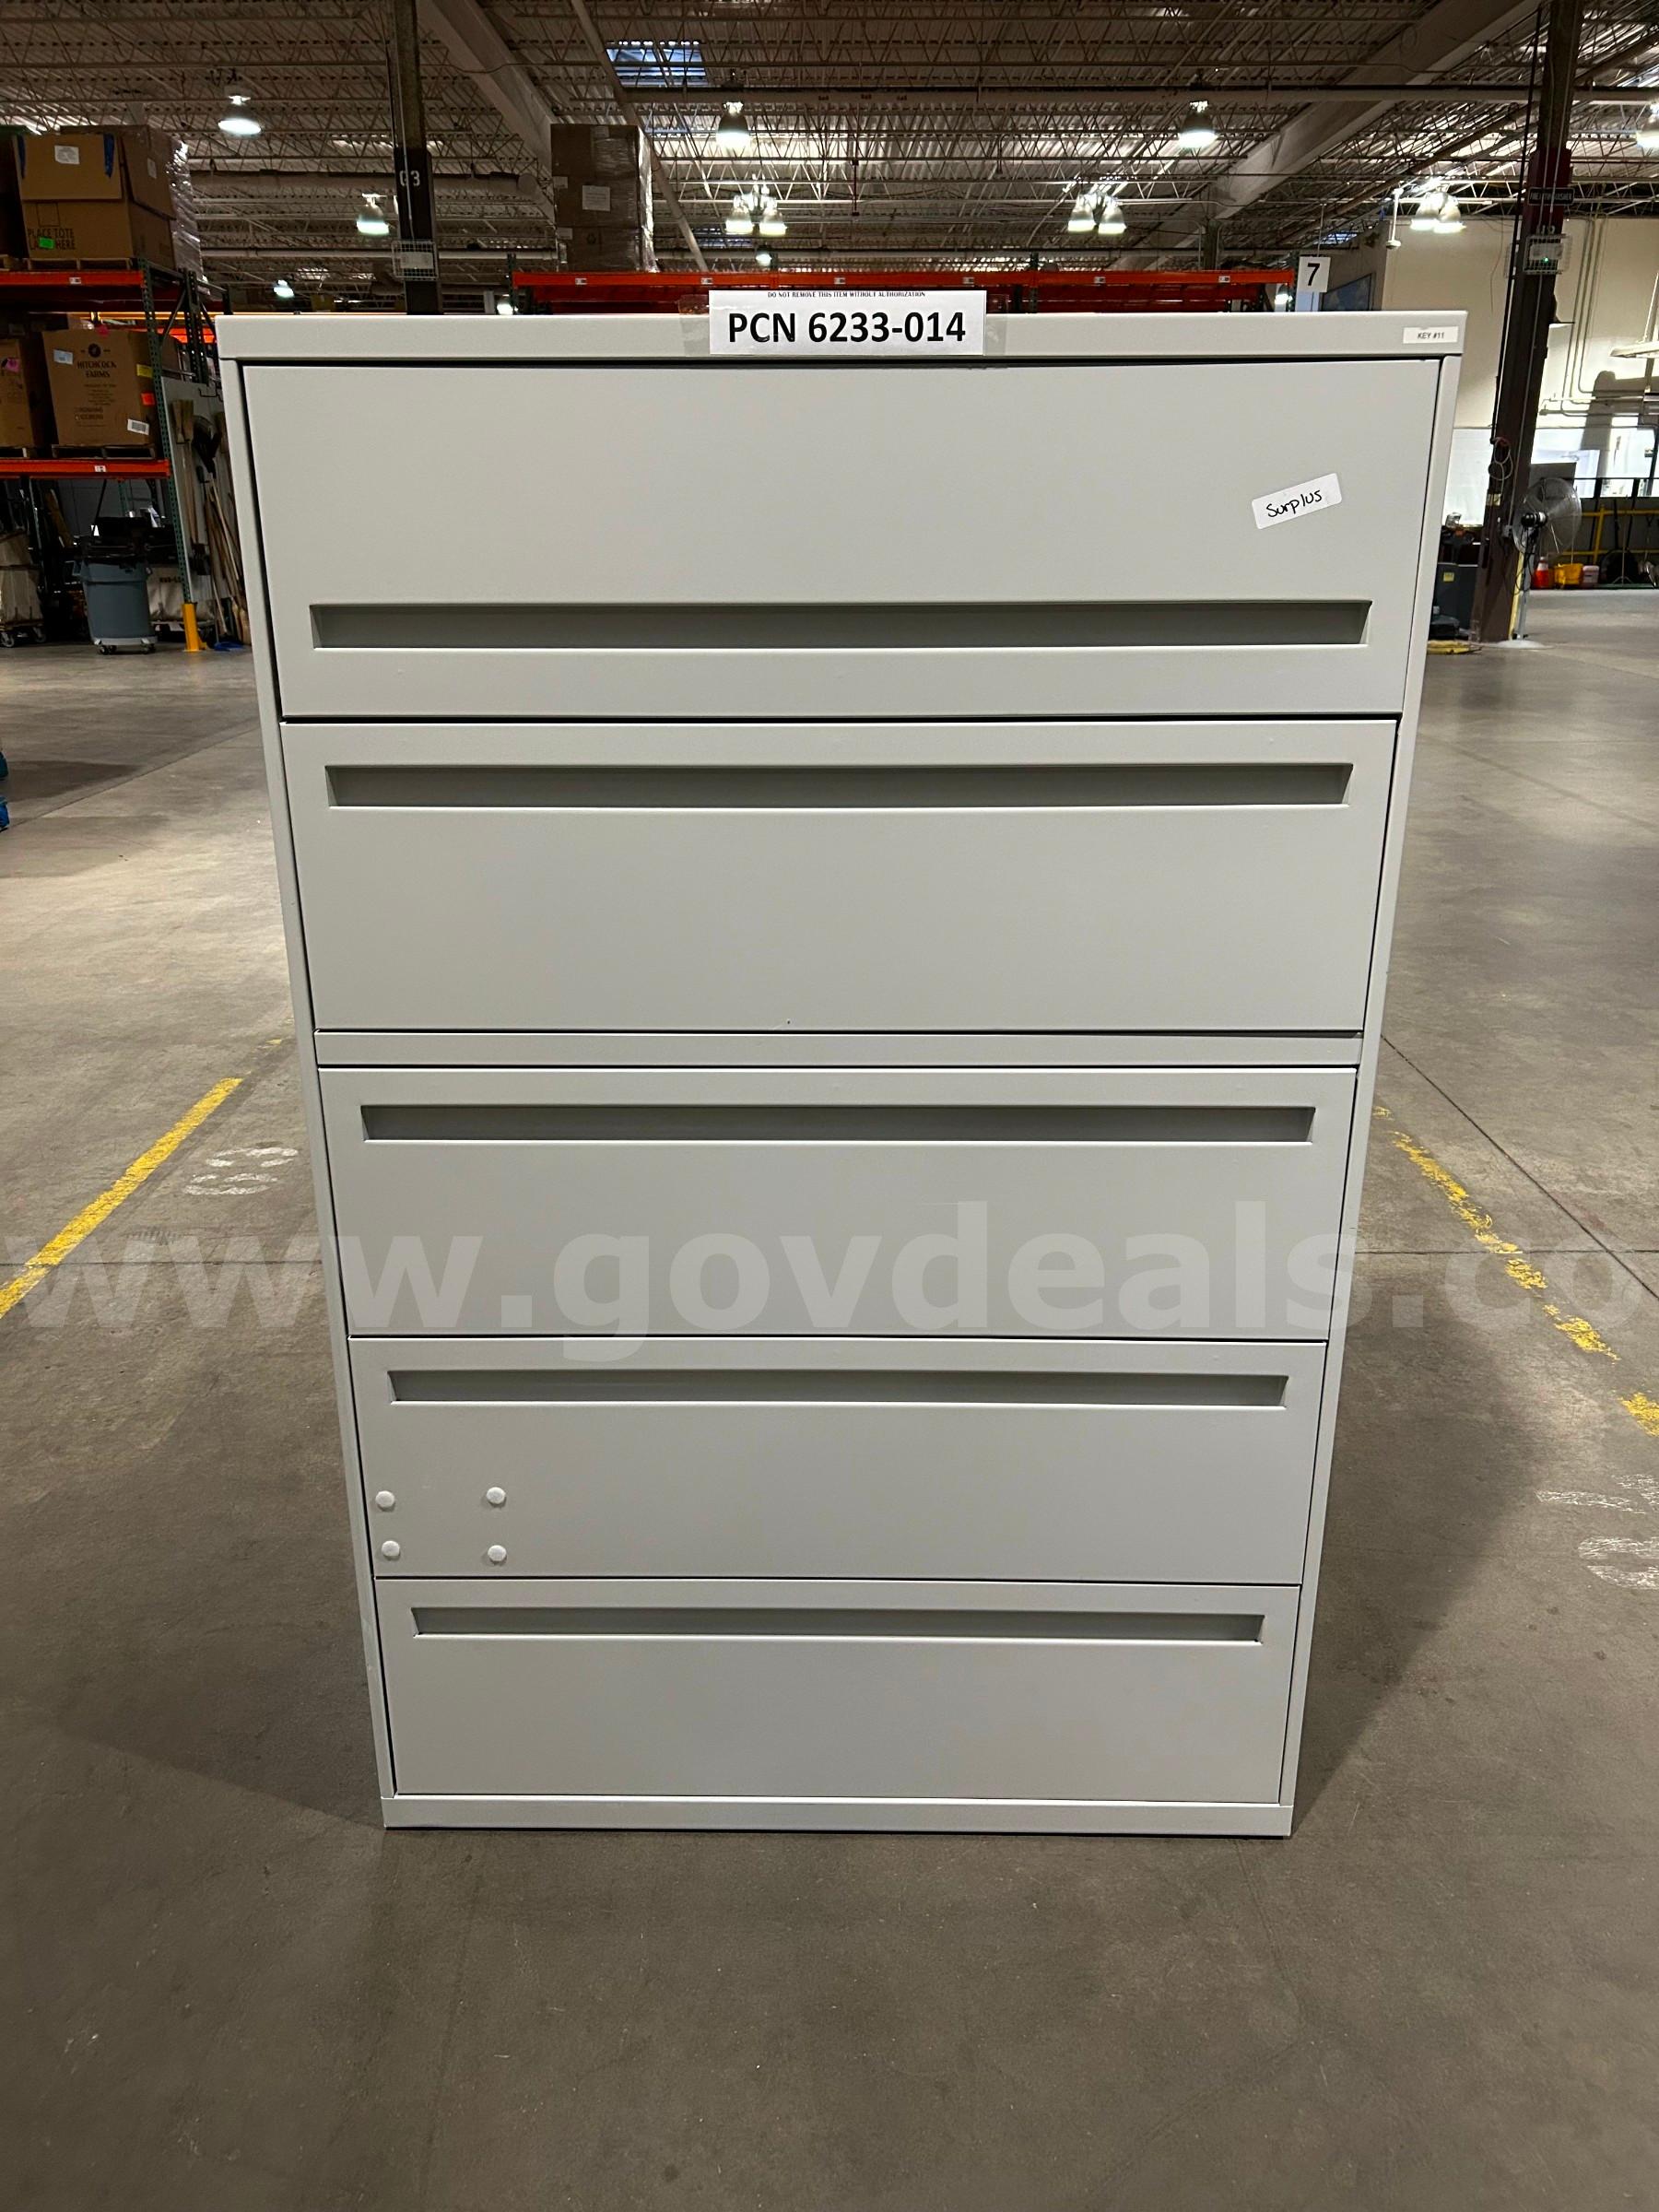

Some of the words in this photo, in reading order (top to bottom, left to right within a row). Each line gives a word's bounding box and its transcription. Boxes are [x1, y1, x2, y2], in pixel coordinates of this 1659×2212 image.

[1307, 263, 1320, 286] 7
[728, 312, 795, 343] PCN
[808, 312, 966, 343] 6233-014
[76, 360, 117, 369] HITCHCOCK
[86, 370, 111, 378] FARMS
[1265, 489, 1323, 518] Surplus
